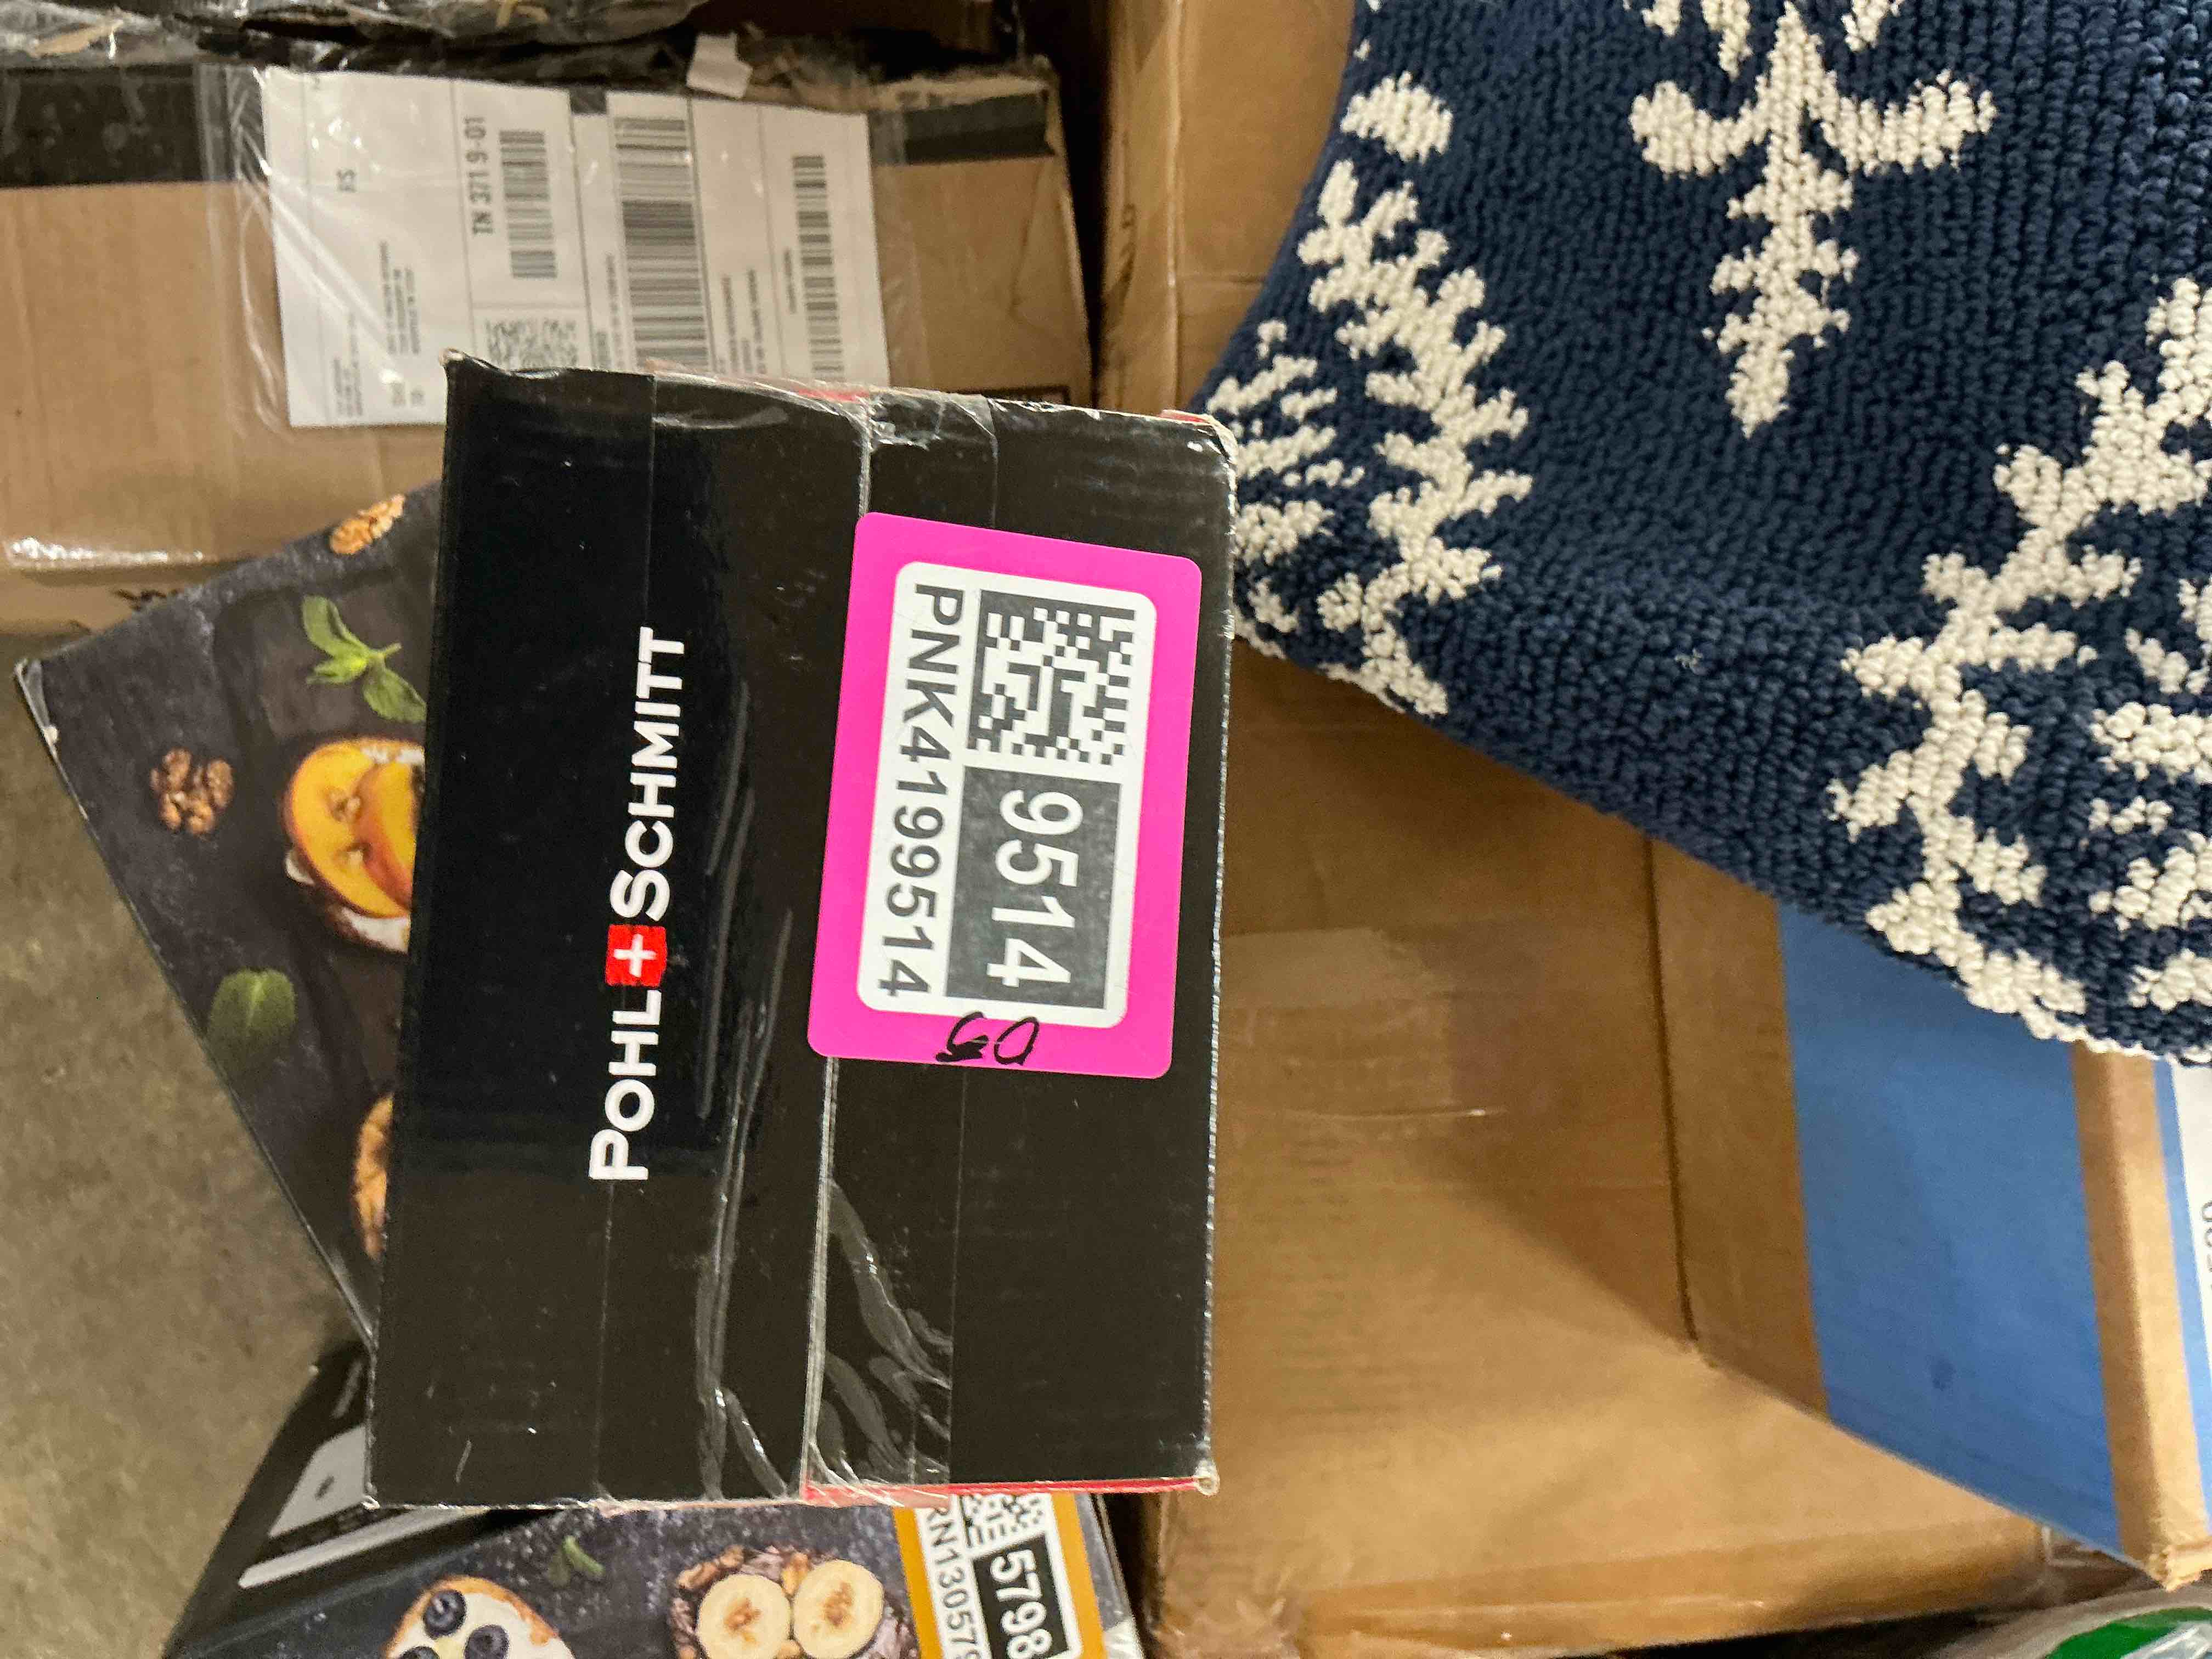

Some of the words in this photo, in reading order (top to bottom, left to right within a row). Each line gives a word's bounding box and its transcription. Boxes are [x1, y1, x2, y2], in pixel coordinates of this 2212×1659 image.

[880, 584, 964, 996] PNK4199514
[986, 789, 1084, 988] 9514
[990, 1549, 1053, 1659] 5798
